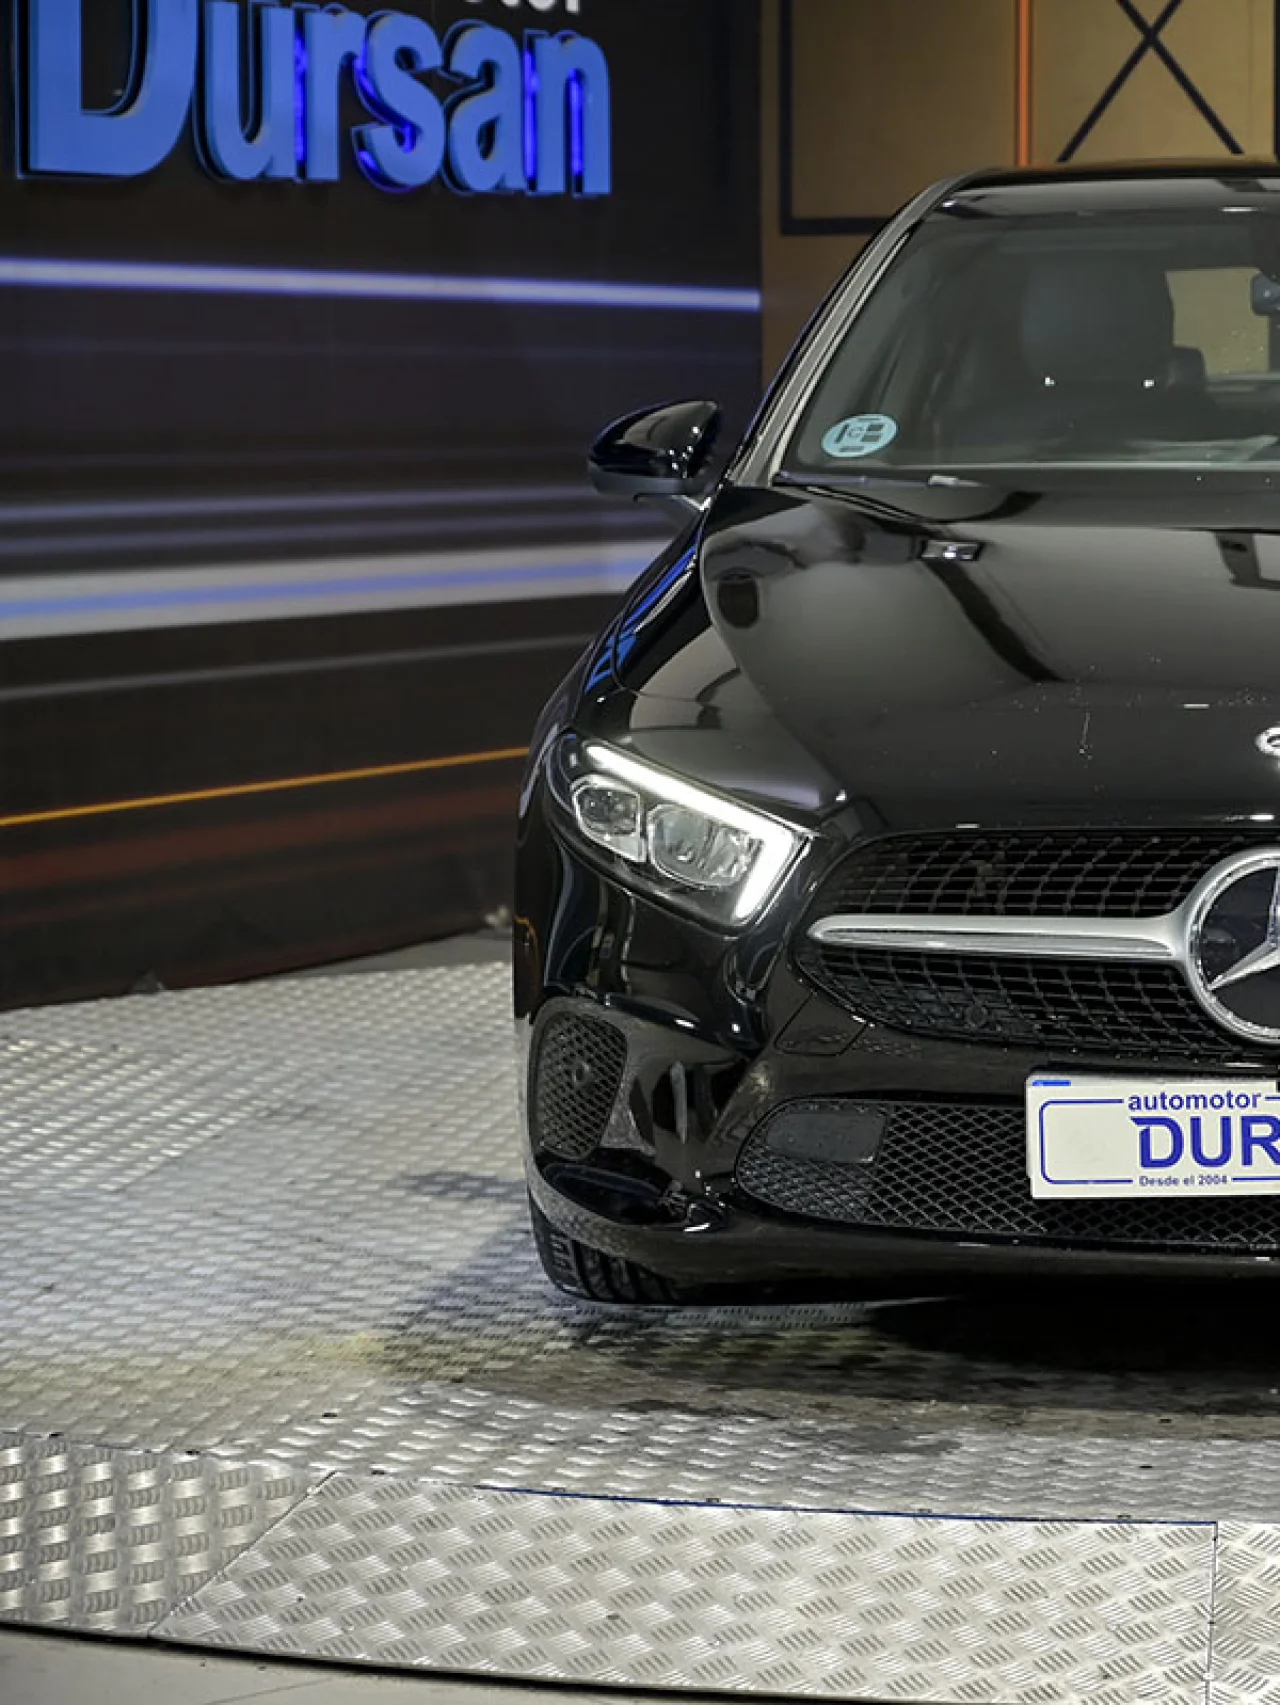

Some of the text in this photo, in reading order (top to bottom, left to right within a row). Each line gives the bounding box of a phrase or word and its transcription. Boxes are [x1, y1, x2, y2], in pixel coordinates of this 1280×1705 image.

[14, 0, 611, 196] Dursan
[1127, 1090, 1261, 1112] automotor
[1138, 1173, 1228, 1187] Desde el 2004
